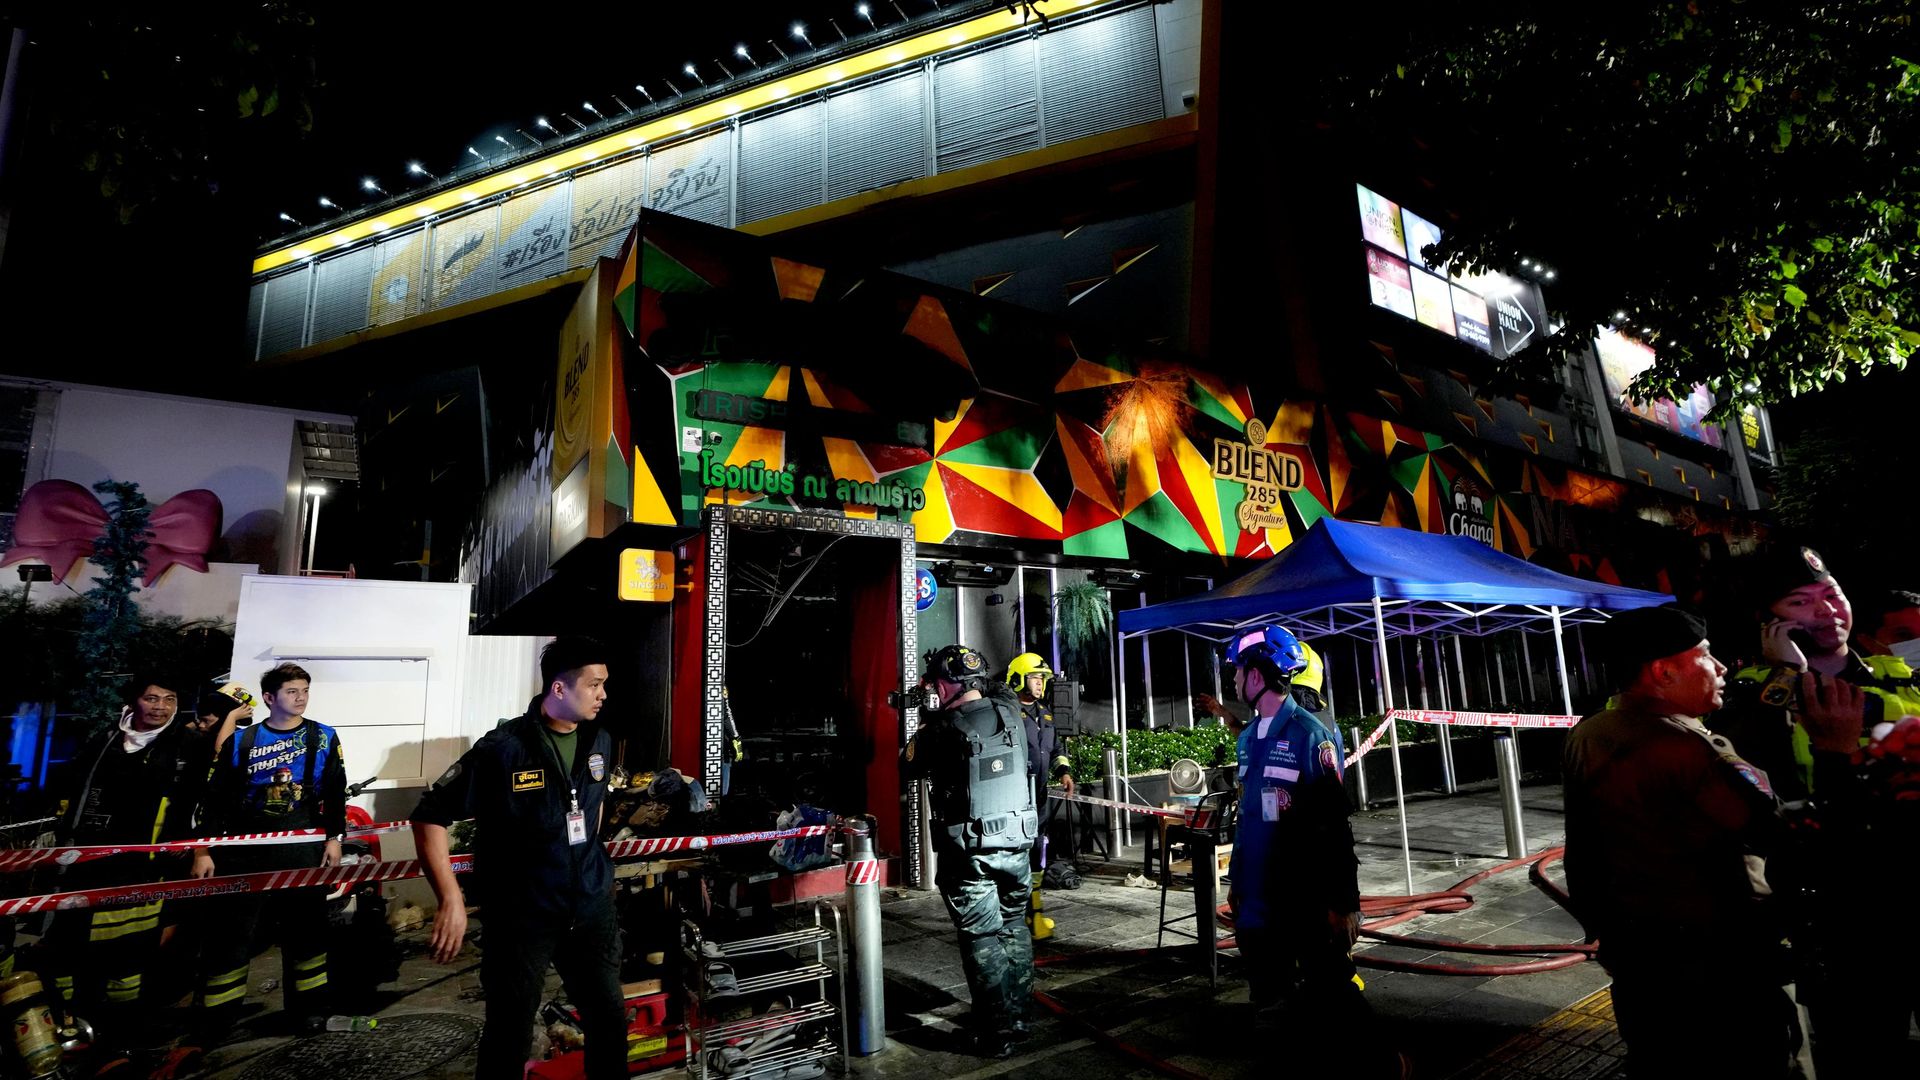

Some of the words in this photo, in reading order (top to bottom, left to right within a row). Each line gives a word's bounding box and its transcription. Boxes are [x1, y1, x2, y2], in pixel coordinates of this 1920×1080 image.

[1497, 298, 1522, 322] UNION
[1498, 312, 1520, 334] HALL
[564, 342, 590, 401] BLEND
[1217, 441, 1301, 489] BLEND
[701, 449, 797, 497] โรงเบียร์
[802, 472, 830, 501] ณ
[834, 480, 926, 511] ลาดพร้าว
[1249, 485, 1277, 505] 285
[1241, 503, 1285, 530] Signature
[1450, 512, 1494, 549] Chang
[629, 581, 668, 591] SINGHA
